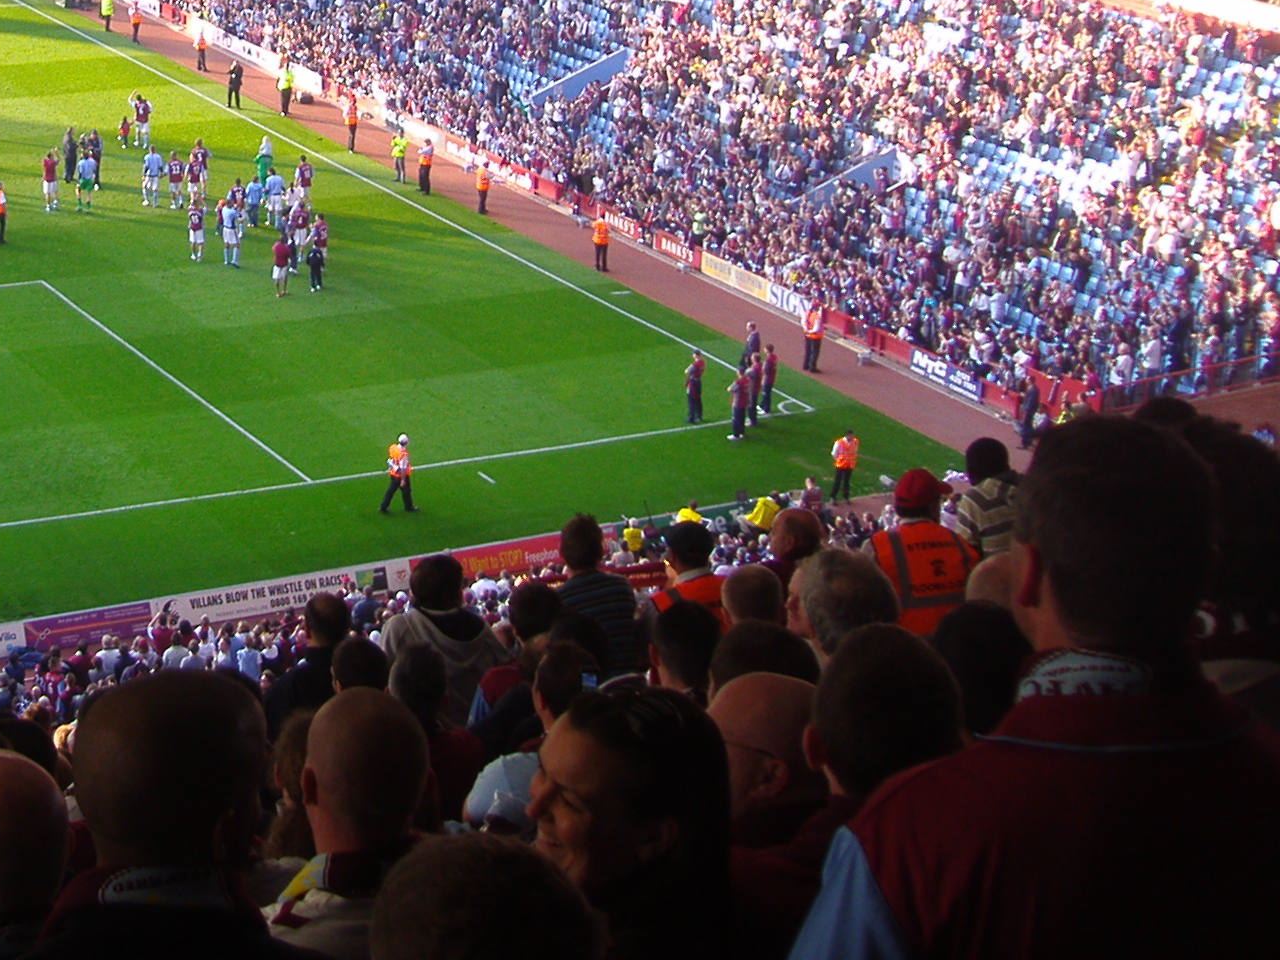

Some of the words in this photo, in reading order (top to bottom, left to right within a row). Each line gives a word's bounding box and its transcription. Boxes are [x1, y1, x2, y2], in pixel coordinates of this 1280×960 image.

[189, 594, 223, 609] VILLANS
[225, 589, 248, 603] BLOW
[251, 586, 265, 599] THE
[268, 581, 303, 596] WHISTLE
[305, 578, 317, 589] ON
